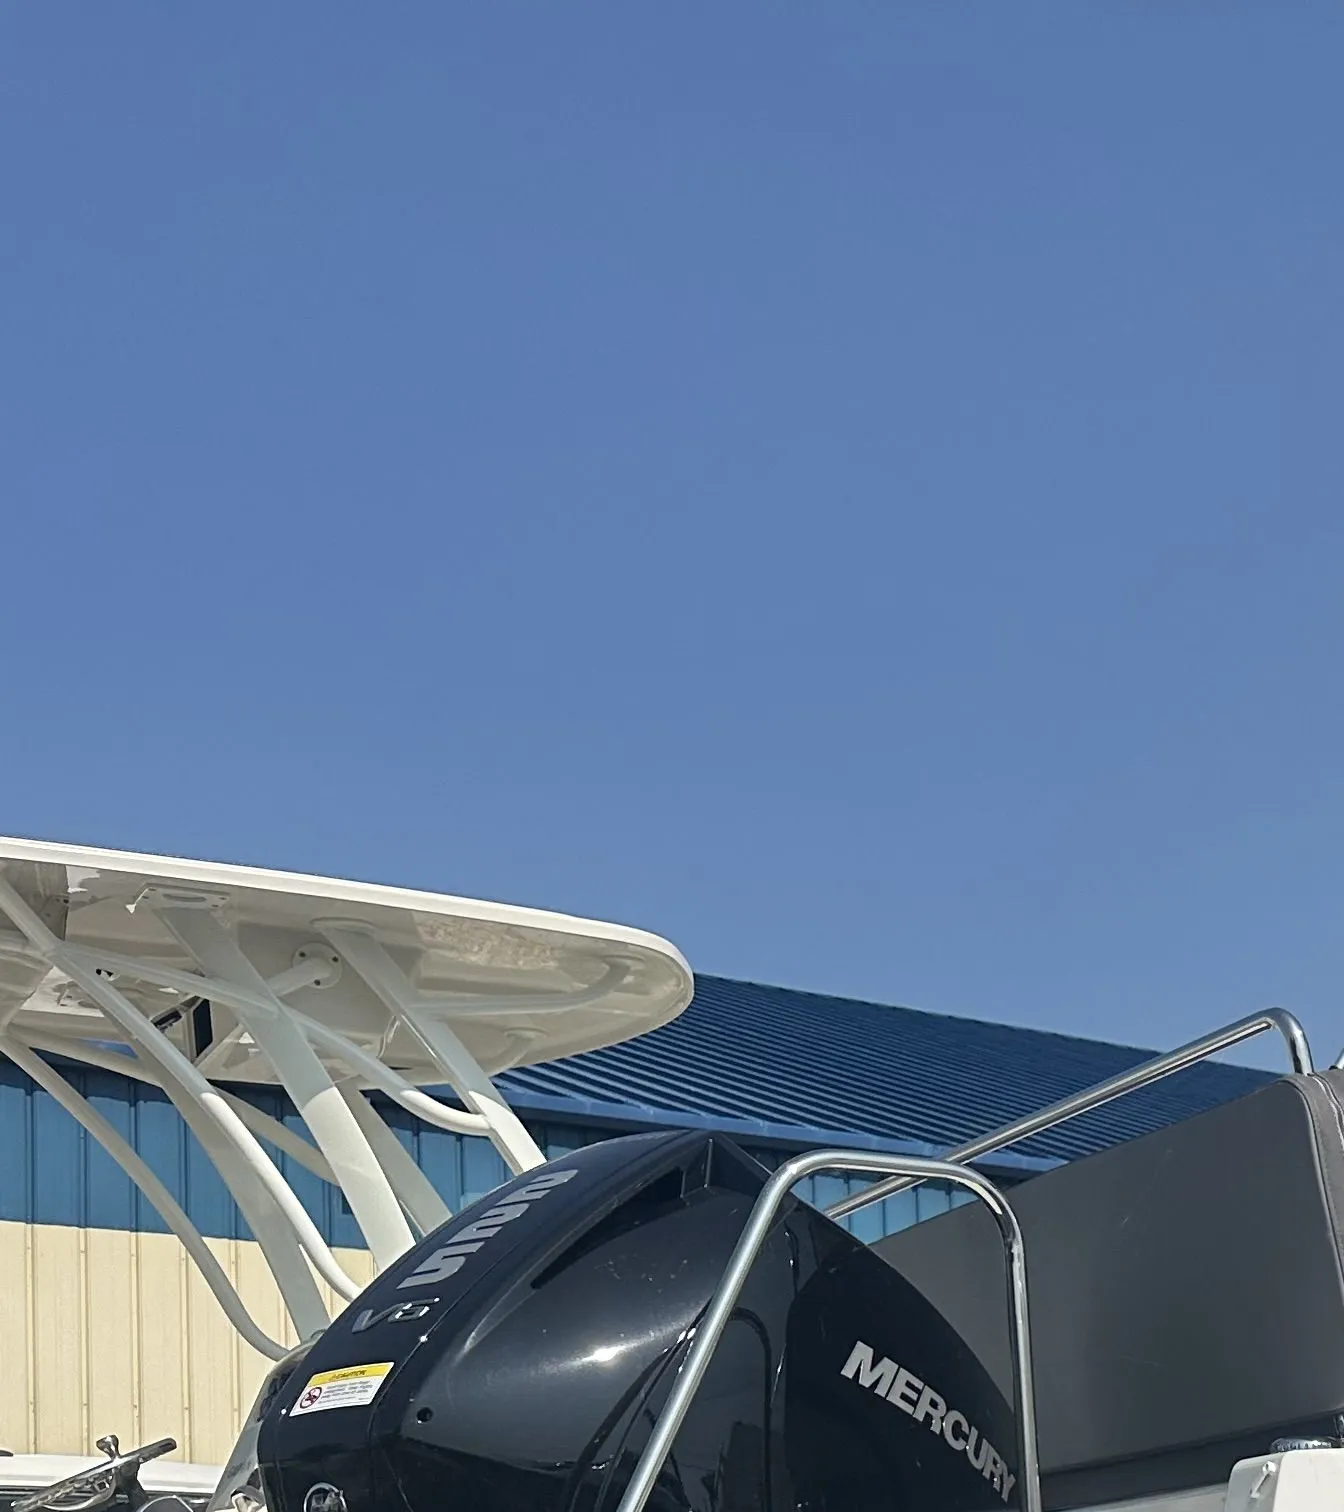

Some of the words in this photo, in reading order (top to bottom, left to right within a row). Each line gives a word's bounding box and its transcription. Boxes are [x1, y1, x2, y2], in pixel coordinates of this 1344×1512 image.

[396, 1169, 579, 1290] 225
[352, 1297, 440, 1335] V6
[840, 1340, 1017, 1503] MERCURY
